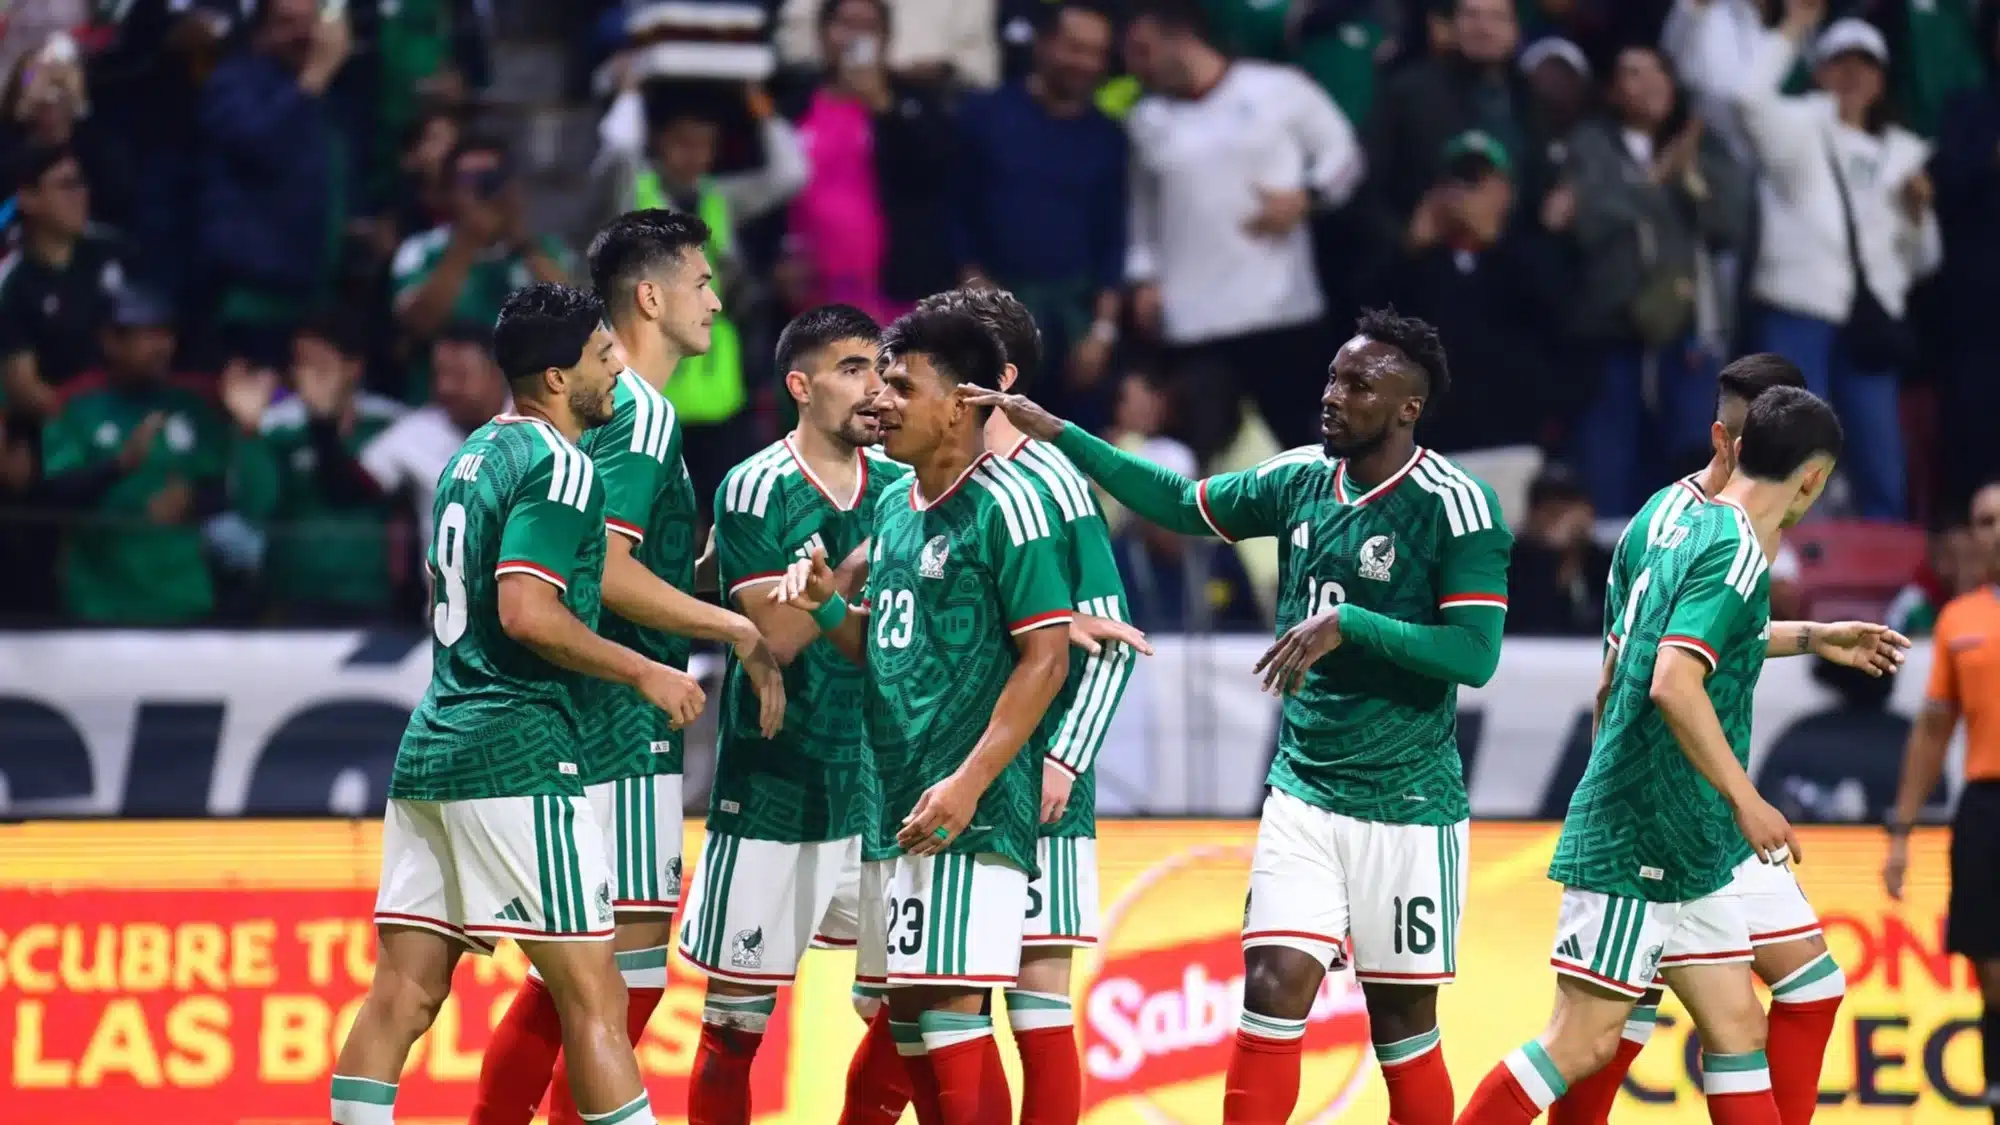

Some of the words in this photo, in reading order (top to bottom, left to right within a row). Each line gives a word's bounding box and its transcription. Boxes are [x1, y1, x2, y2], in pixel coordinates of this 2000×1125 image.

[434, 502, 468, 648] 9
[878, 589, 914, 648] 23
[887, 897, 925, 956] 23
[1393, 896, 1437, 955] 16
[12, 995, 234, 1088] LAS
